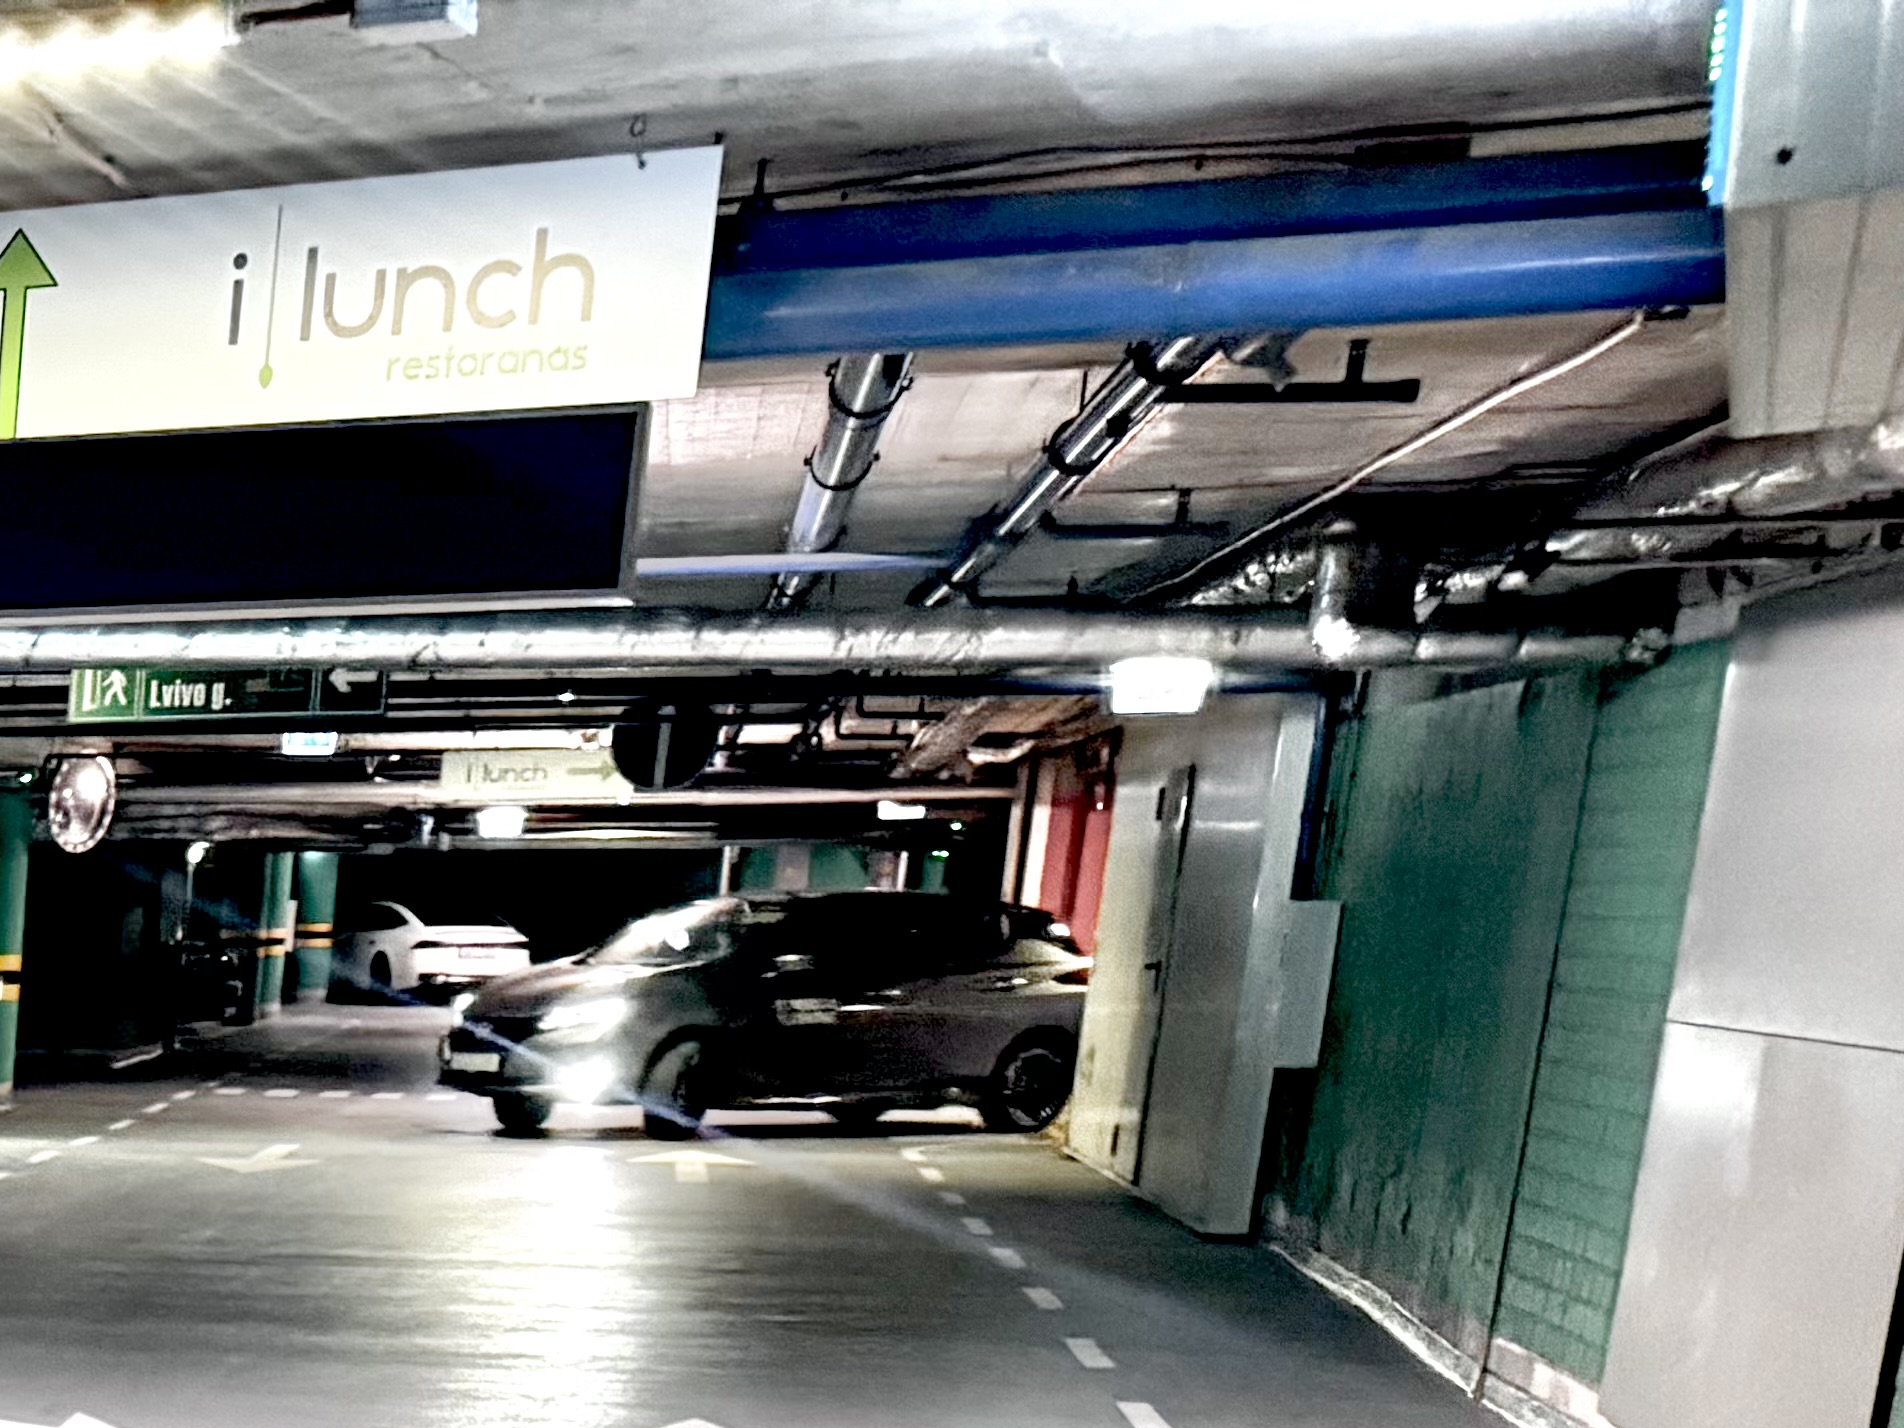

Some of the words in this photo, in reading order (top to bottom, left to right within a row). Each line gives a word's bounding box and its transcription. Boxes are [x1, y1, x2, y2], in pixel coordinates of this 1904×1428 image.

[299, 226, 596, 342] lunch
[385, 343, 590, 382] restoranas
[148, 677, 207, 709] Lvivo
[210, 681, 233, 711] g.
[481, 761, 549, 784] lunch
